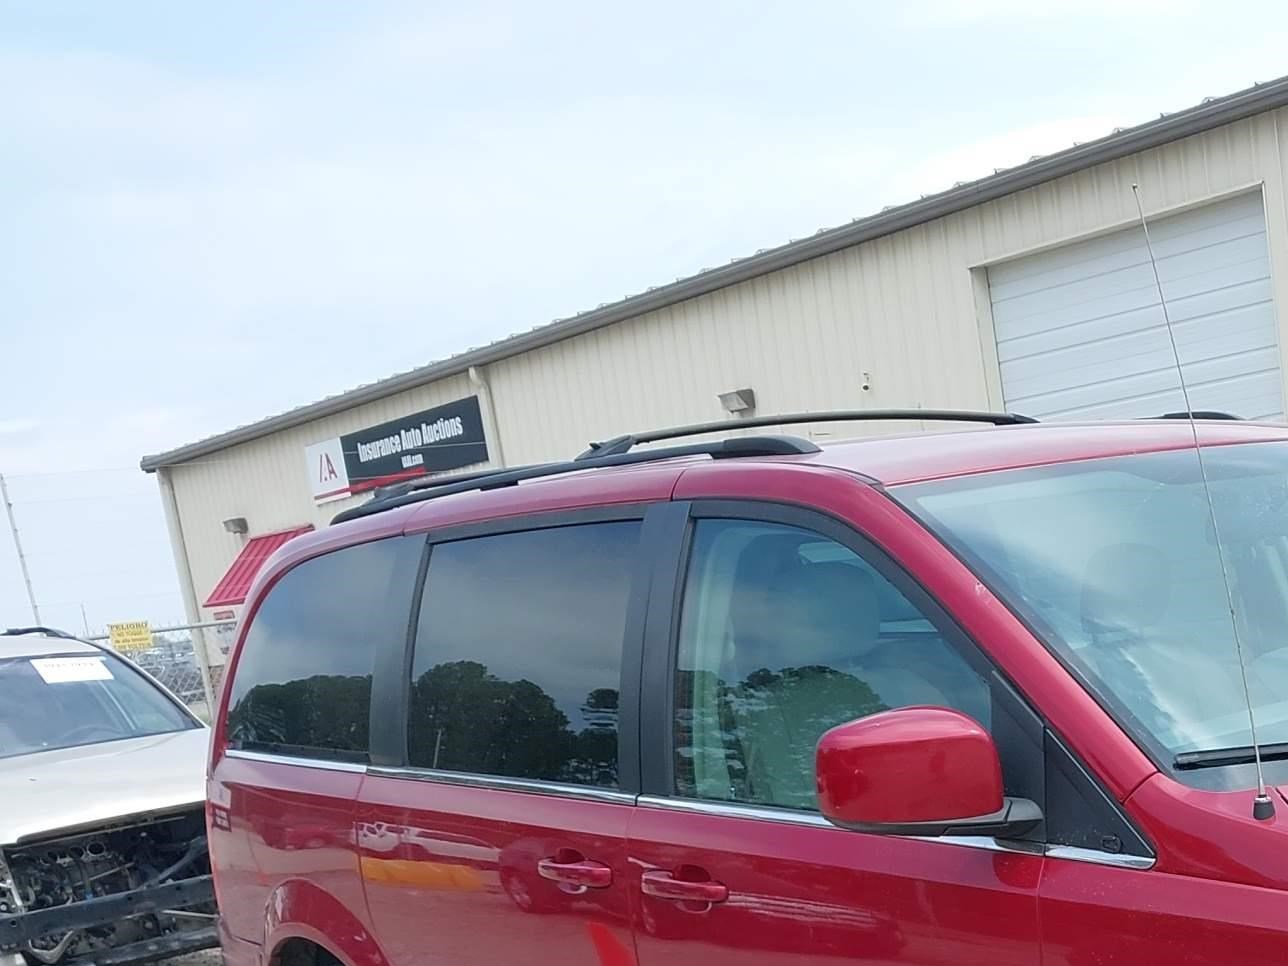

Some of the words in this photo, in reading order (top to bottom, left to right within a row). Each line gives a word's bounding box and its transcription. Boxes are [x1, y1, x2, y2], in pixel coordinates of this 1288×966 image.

[357, 434, 402, 463] Insurance
[400, 428, 422, 451] Auto
[421, 416, 464, 445] Auctions
